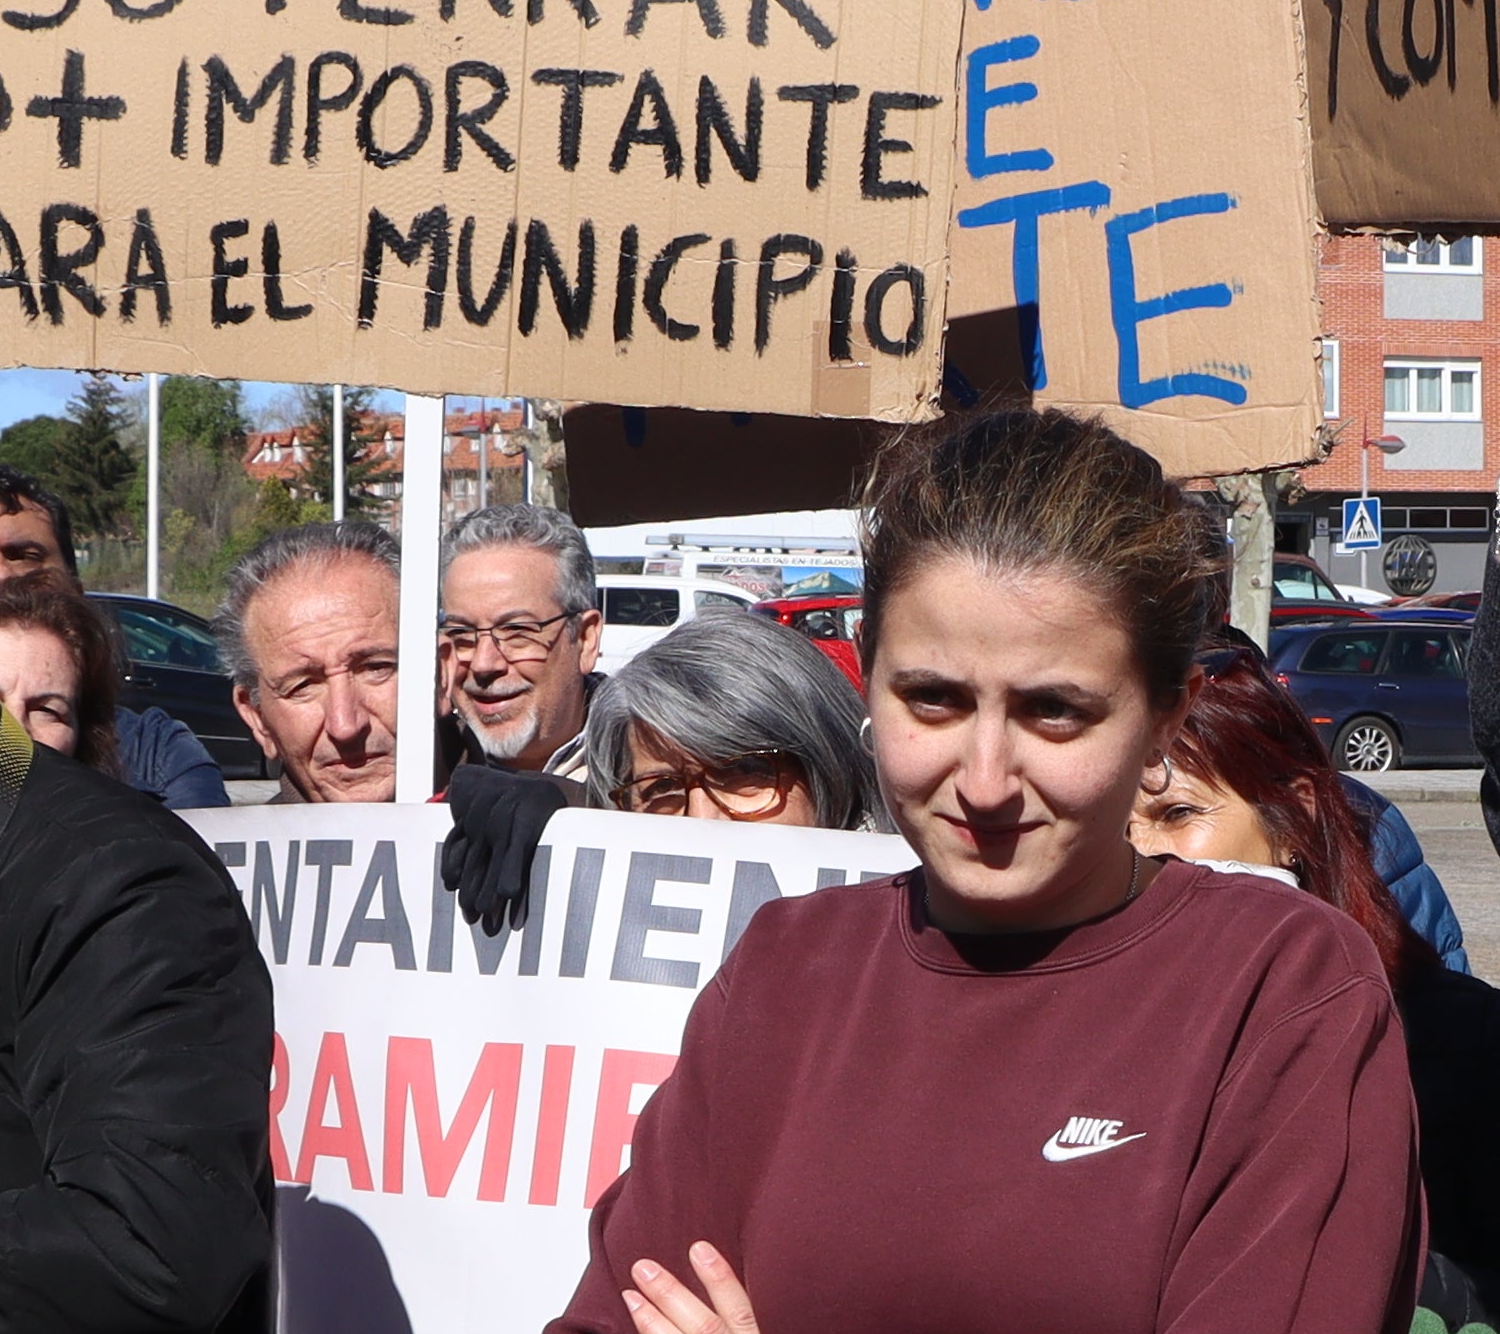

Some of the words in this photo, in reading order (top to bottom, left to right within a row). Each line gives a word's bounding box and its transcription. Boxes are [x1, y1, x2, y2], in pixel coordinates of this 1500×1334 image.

[172, 51, 944, 201] IMPORTANTE
[208, 217, 315, 327] EL
[357, 203, 928, 363] MUNICIPIO
[713, 554, 789, 565] ESPECIALISTAS
[791, 557, 806, 565] EN
[810, 557, 857, 567] TEJADOS
[214, 839, 892, 990] NTAMIE
[1058, 1115, 1125, 1147] NIKE
